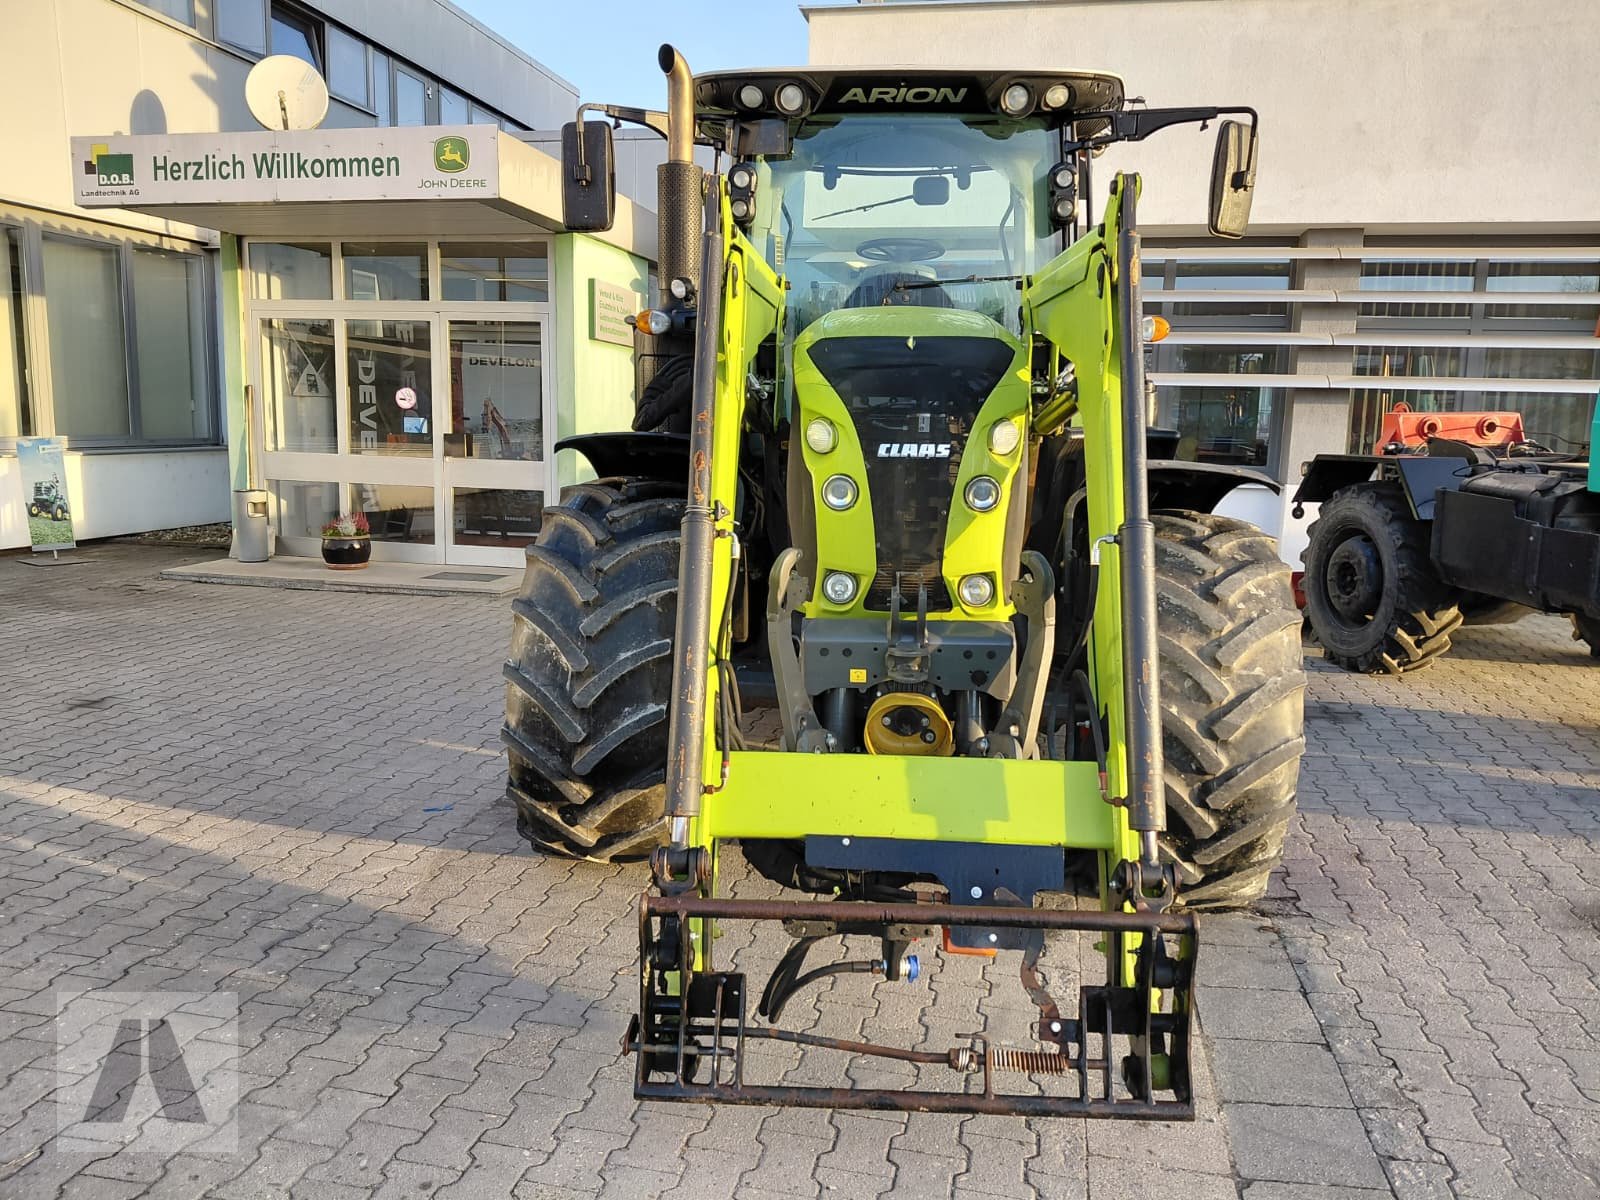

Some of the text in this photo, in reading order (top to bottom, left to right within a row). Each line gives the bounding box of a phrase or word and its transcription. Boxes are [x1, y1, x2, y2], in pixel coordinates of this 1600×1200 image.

[837, 87, 968, 103] ARION
[153, 152, 400, 181] Herzlich Willkommen
[99, 173, 134, 185] D.O.B.
[417, 178, 487, 189] JOHN DEERE
[81, 189, 126, 197] Landtechnik
[469, 356, 536, 368] DEVELON
[877, 443, 951, 458] CLAAS
